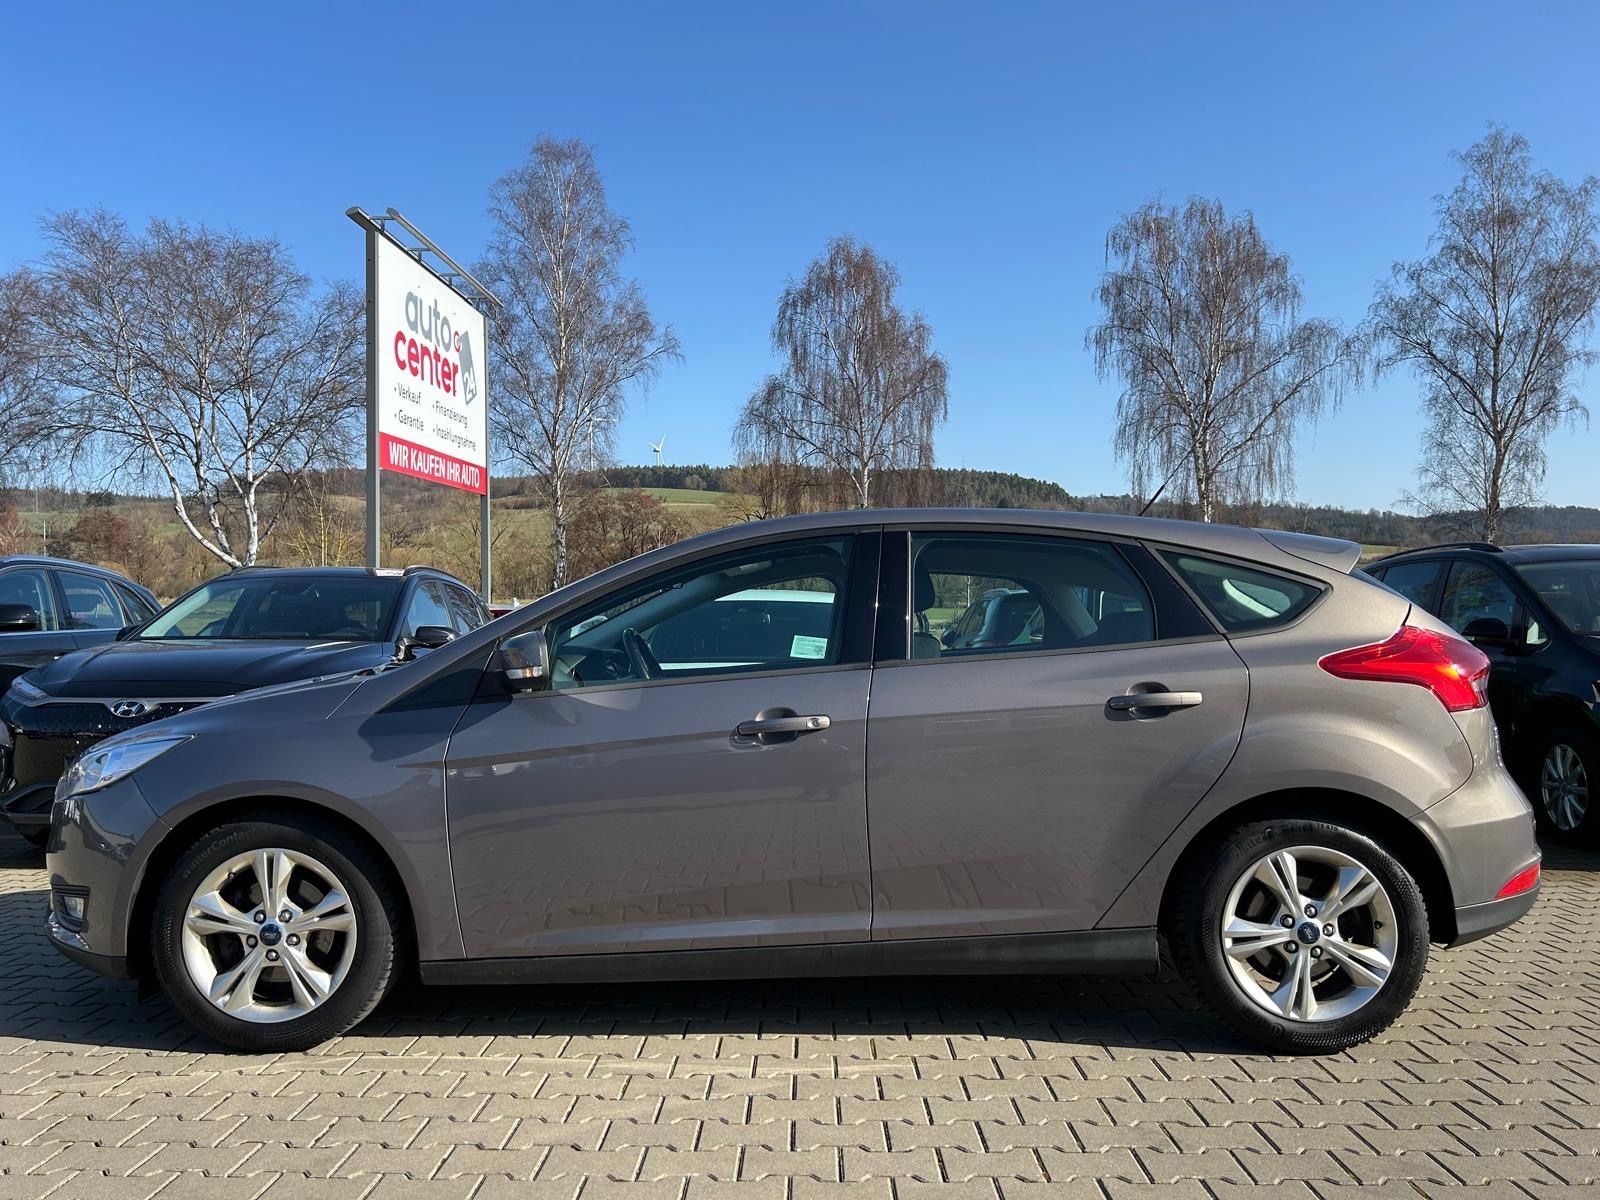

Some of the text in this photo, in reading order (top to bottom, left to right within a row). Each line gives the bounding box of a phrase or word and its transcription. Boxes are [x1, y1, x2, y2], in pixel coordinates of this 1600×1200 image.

[405, 292, 452, 352] auto
[394, 330, 459, 397] center
[398, 382, 422, 404] Verkauf
[463, 366, 476, 402] 24
[399, 409, 424, 431] Garantie
[436, 401, 468, 429] Finanzierung
[436, 424, 476, 451] Inzahlungnahme
[389, 441, 480, 488] WIR KAUFEN IHR AUTO
